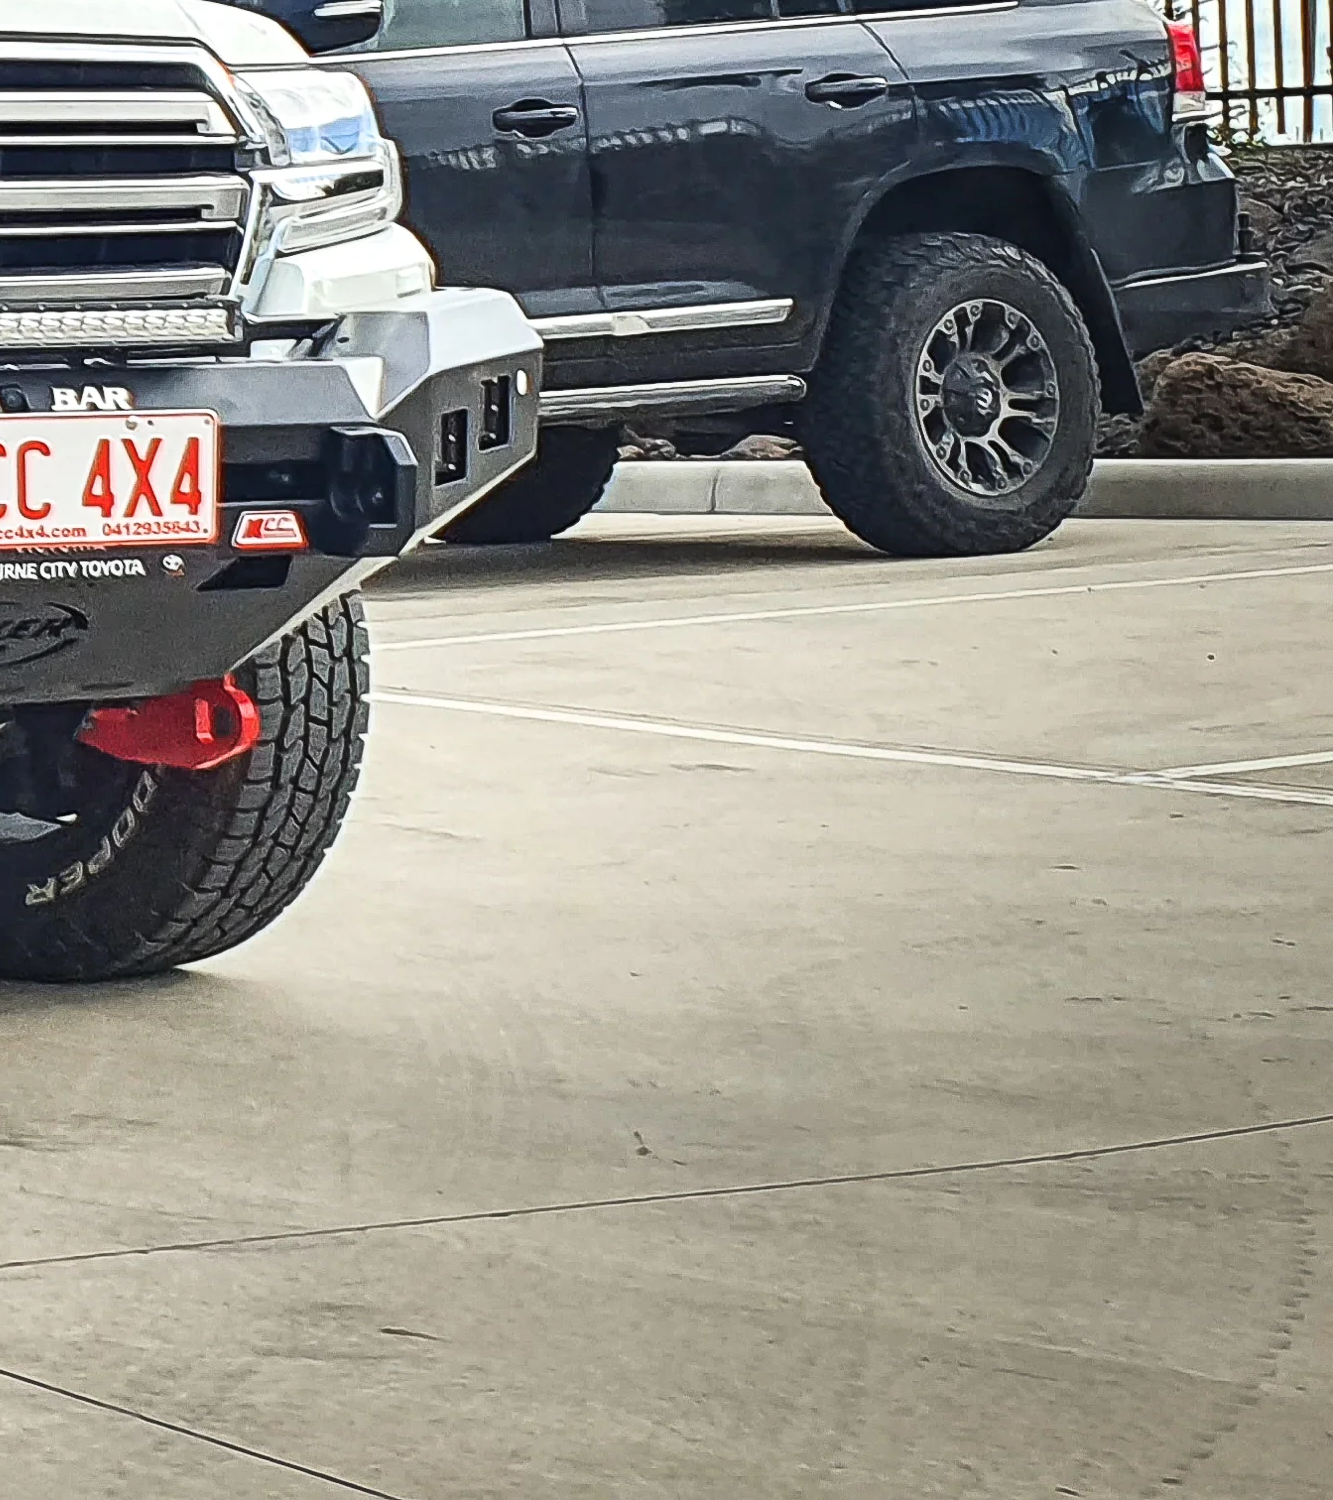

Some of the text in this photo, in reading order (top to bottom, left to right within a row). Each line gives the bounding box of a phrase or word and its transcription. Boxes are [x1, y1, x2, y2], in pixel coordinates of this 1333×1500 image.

[51, 386, 133, 411] BAR
[82, 437, 202, 518] 4X4
[39, 561, 79, 580] CITY
[79, 559, 147, 578] TOYOTA
